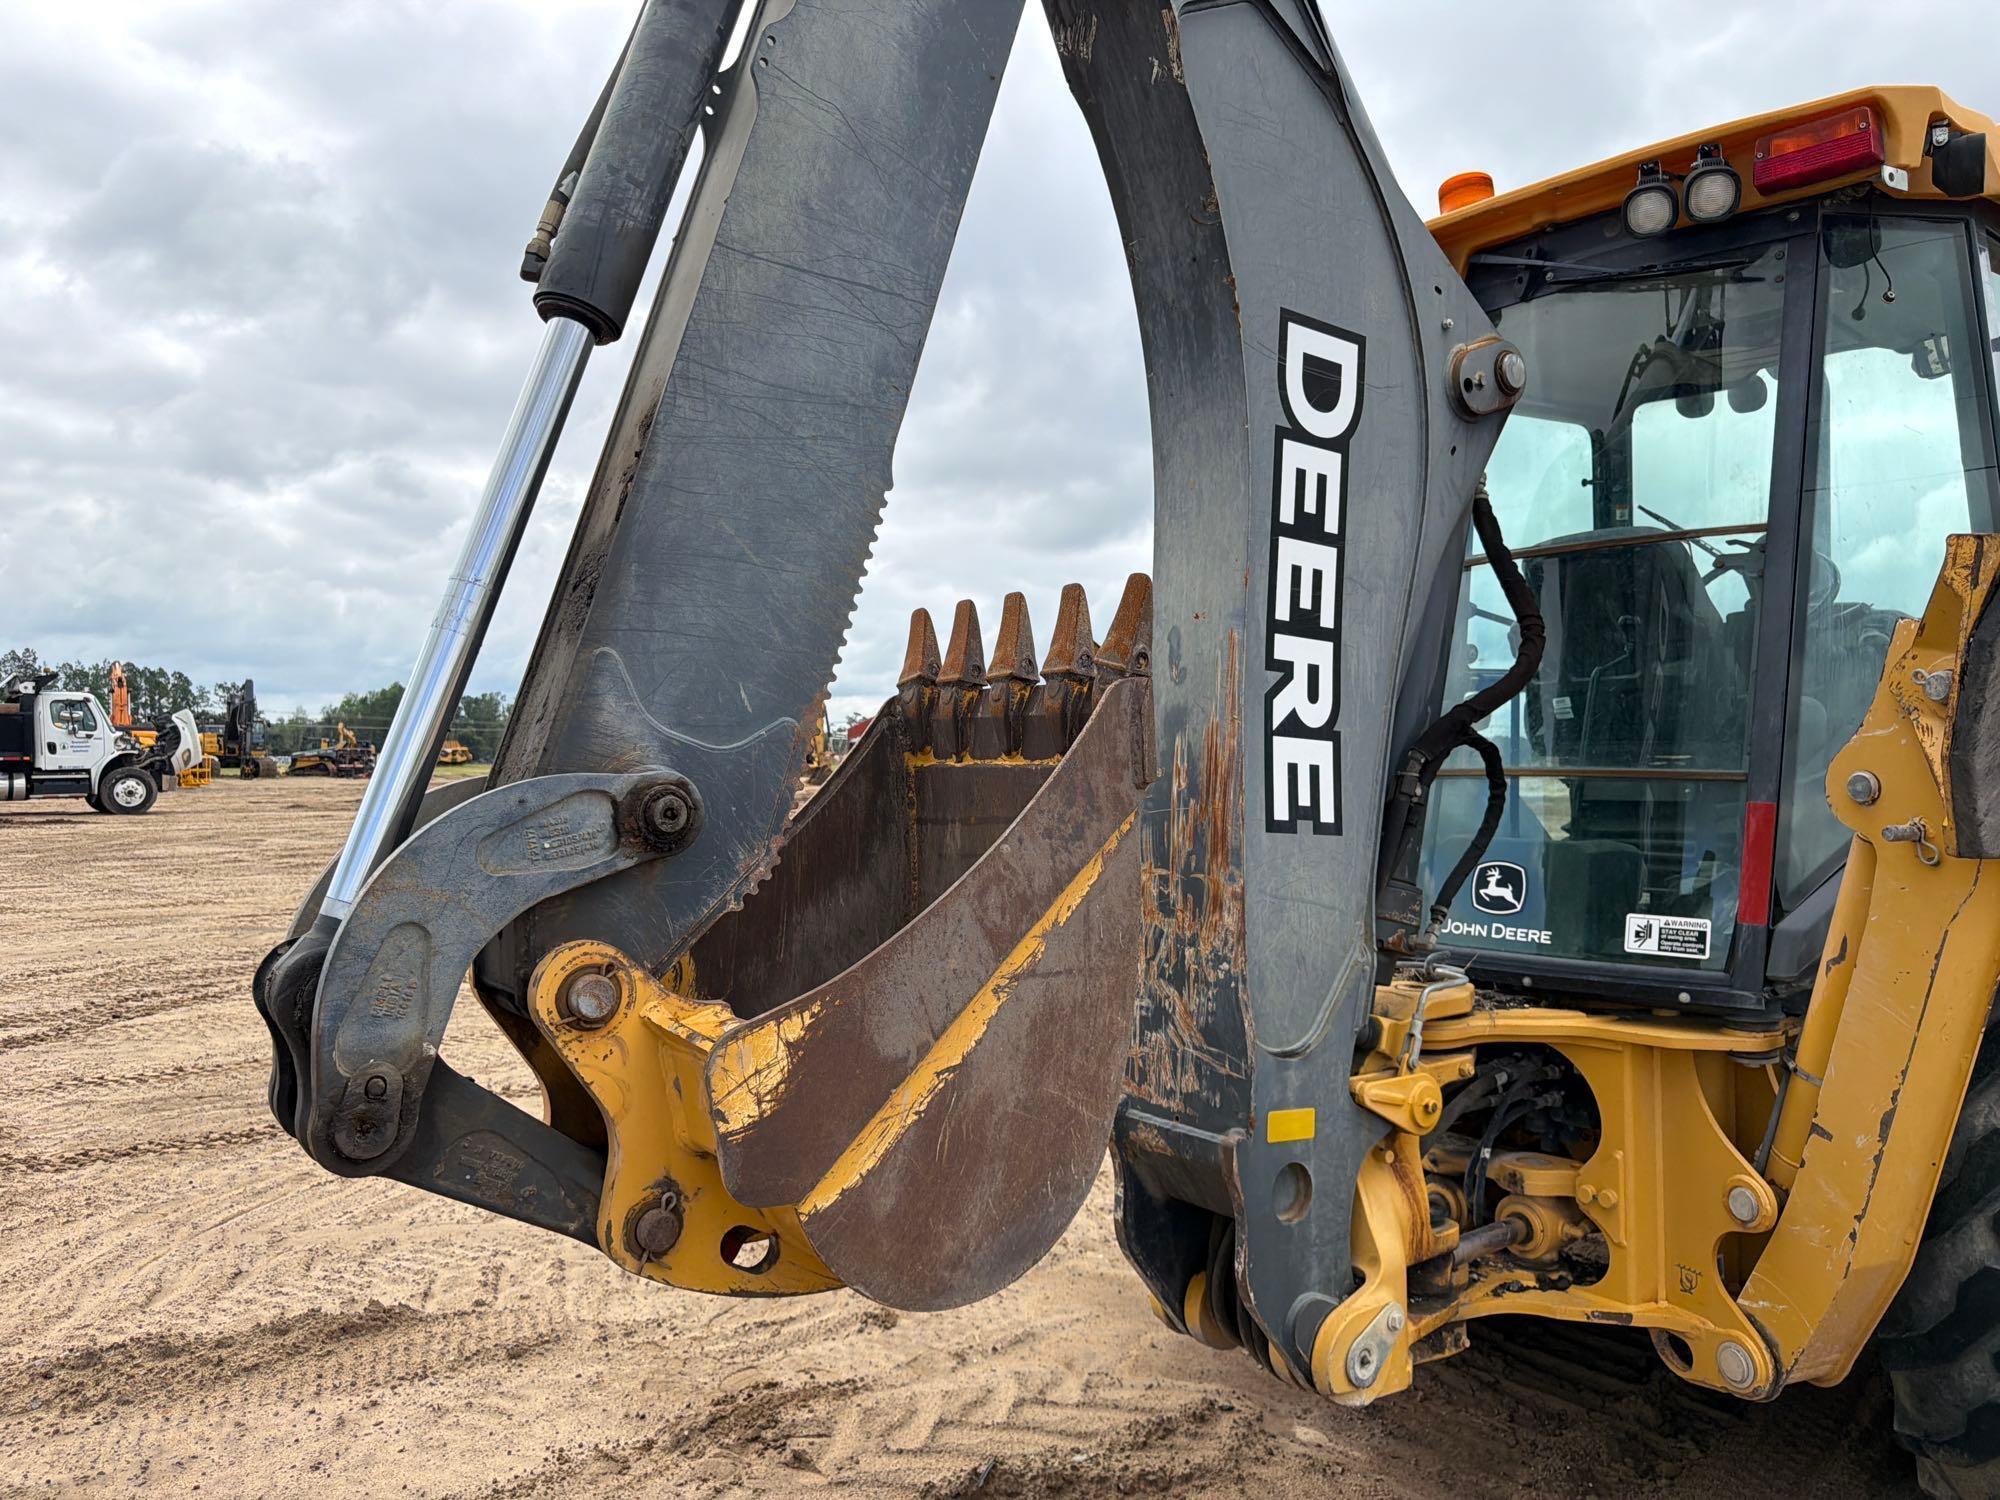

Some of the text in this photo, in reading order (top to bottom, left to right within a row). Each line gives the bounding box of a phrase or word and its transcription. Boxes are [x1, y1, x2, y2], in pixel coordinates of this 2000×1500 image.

[1271, 320, 1360, 825] DEERE
[1441, 918, 1553, 945] JOHN DEERE
[1671, 920, 1708, 929] WARNING
